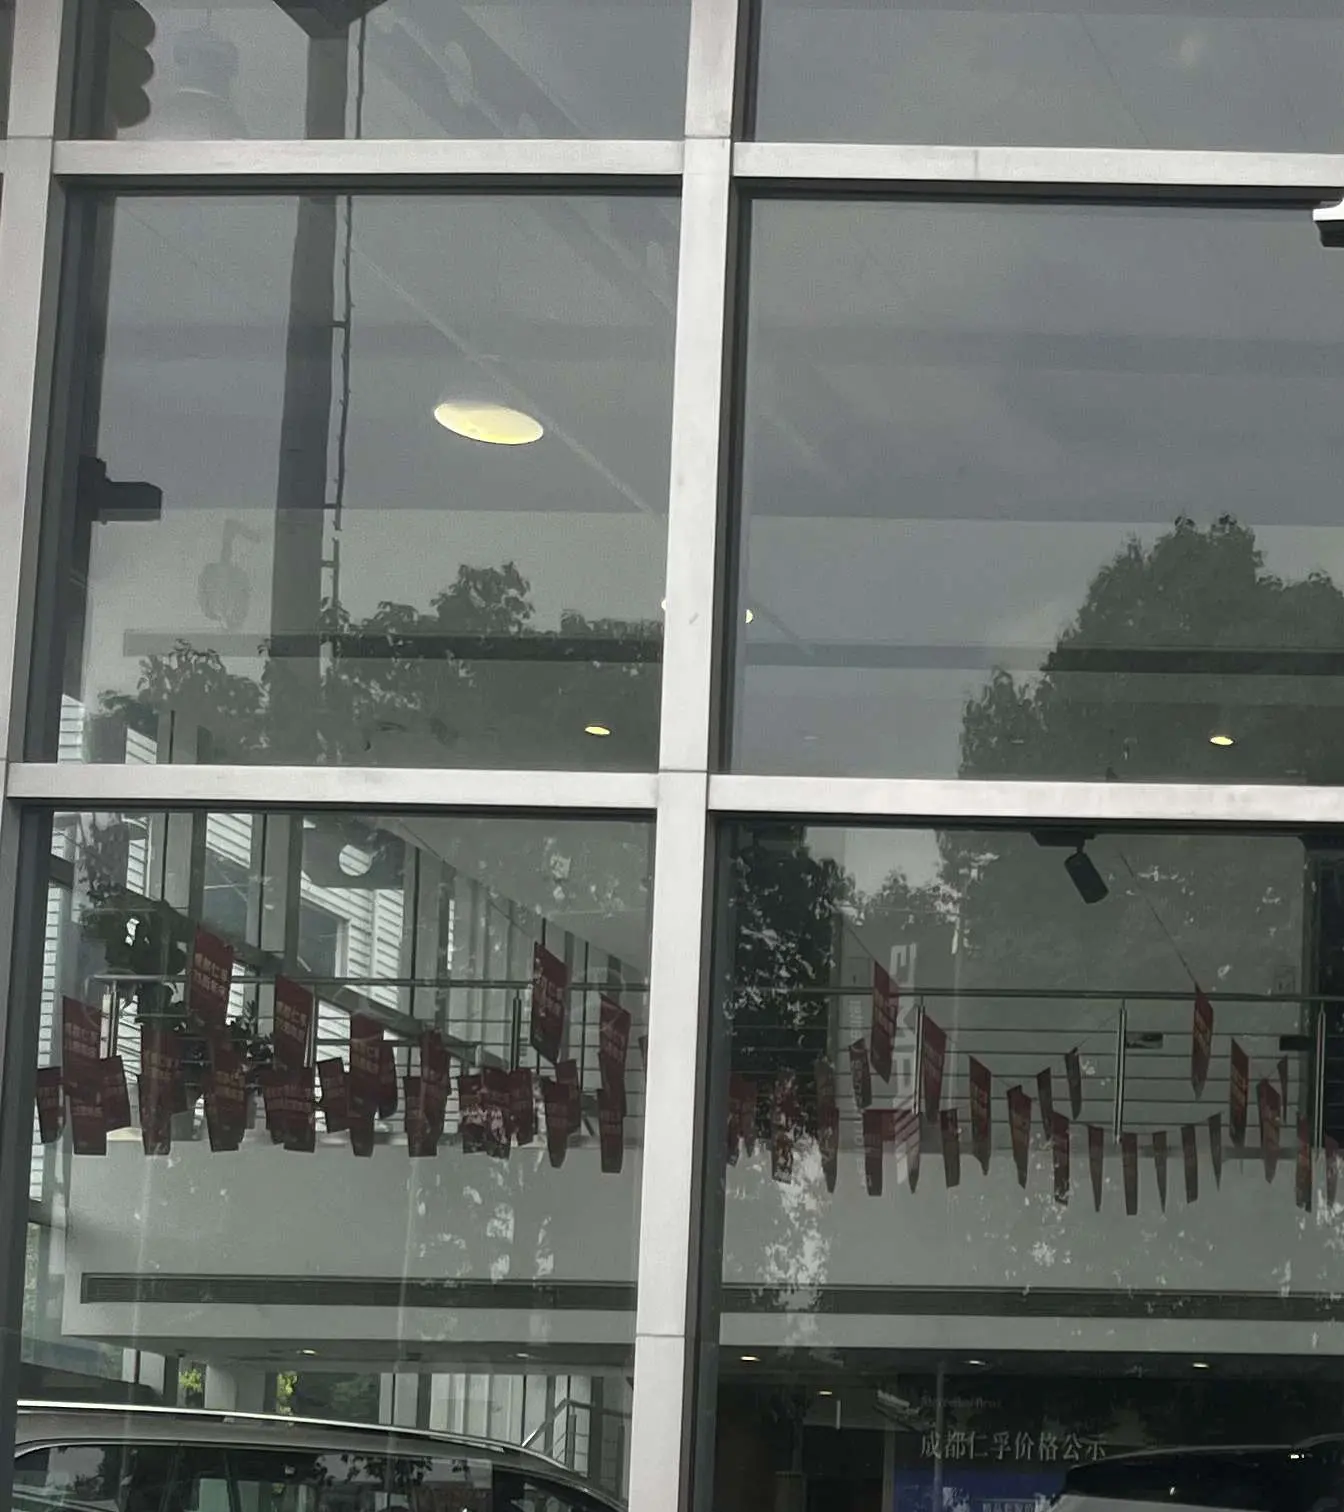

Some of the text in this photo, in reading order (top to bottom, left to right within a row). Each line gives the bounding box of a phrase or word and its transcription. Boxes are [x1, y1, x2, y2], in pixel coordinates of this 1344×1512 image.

[921, 1431, 1107, 1461] 成都仁孚价格公示
